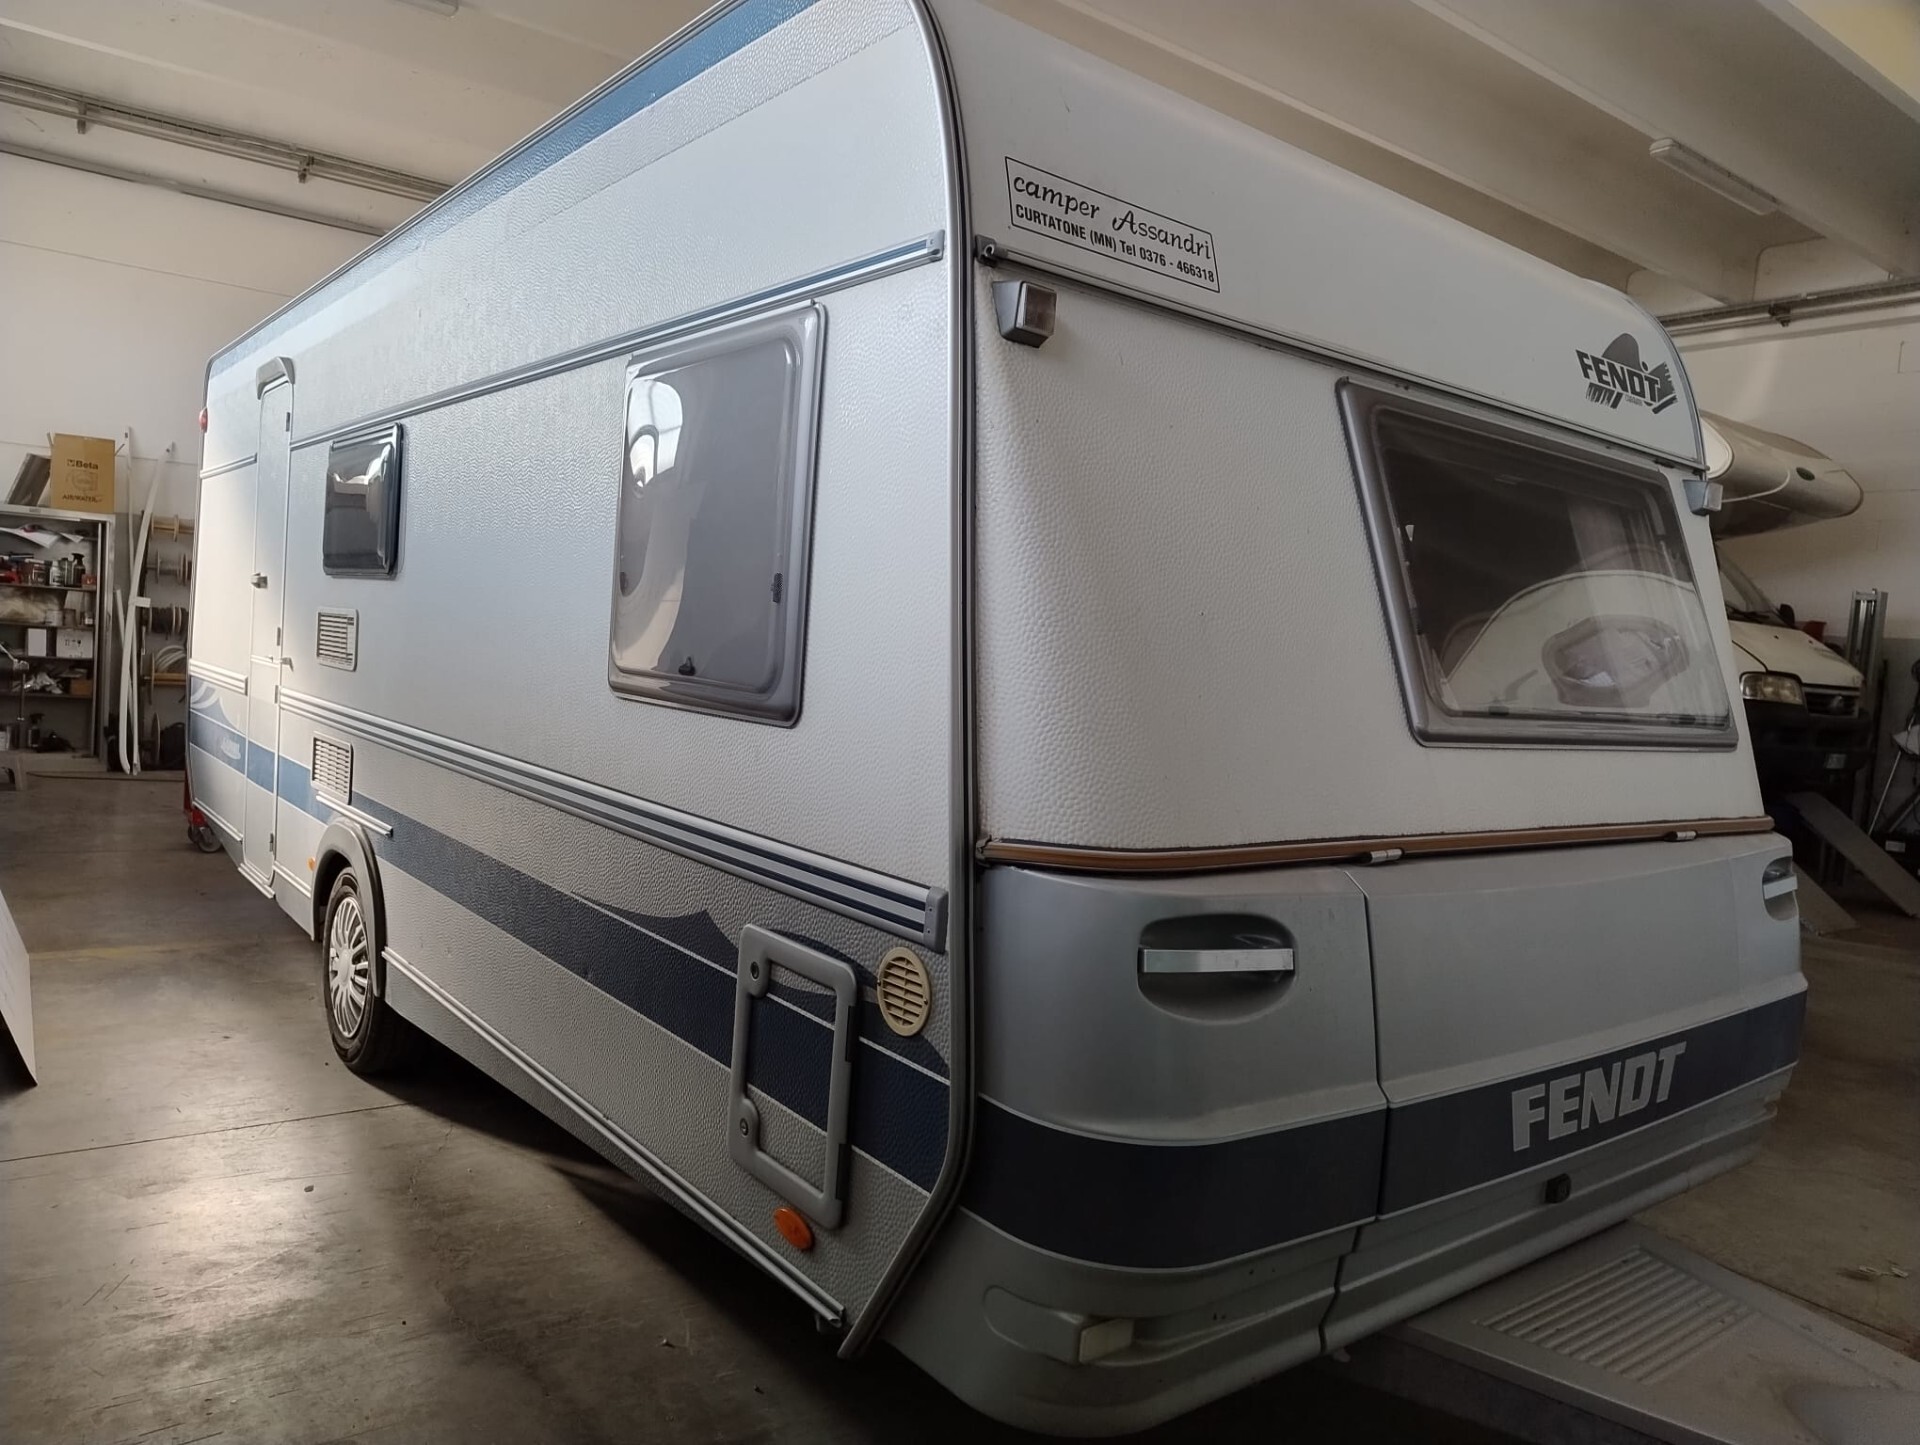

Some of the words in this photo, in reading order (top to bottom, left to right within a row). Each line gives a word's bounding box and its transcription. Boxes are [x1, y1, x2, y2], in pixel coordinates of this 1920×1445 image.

[1013, 176, 1100, 219] camper
[1112, 210, 1211, 259] Assandri
[1016, 204, 1087, 240] CURTATONE
[1090, 229, 1117, 252] (MN)
[1119, 240, 1136, 257] Tel
[1139, 247, 1166, 267] 0376
[1176, 262, 1215, 283] 466318
[1575, 349, 1660, 404] FENDT
[75, 460, 99, 470] Beta
[1511, 1041, 1688, 1152] FENDT
